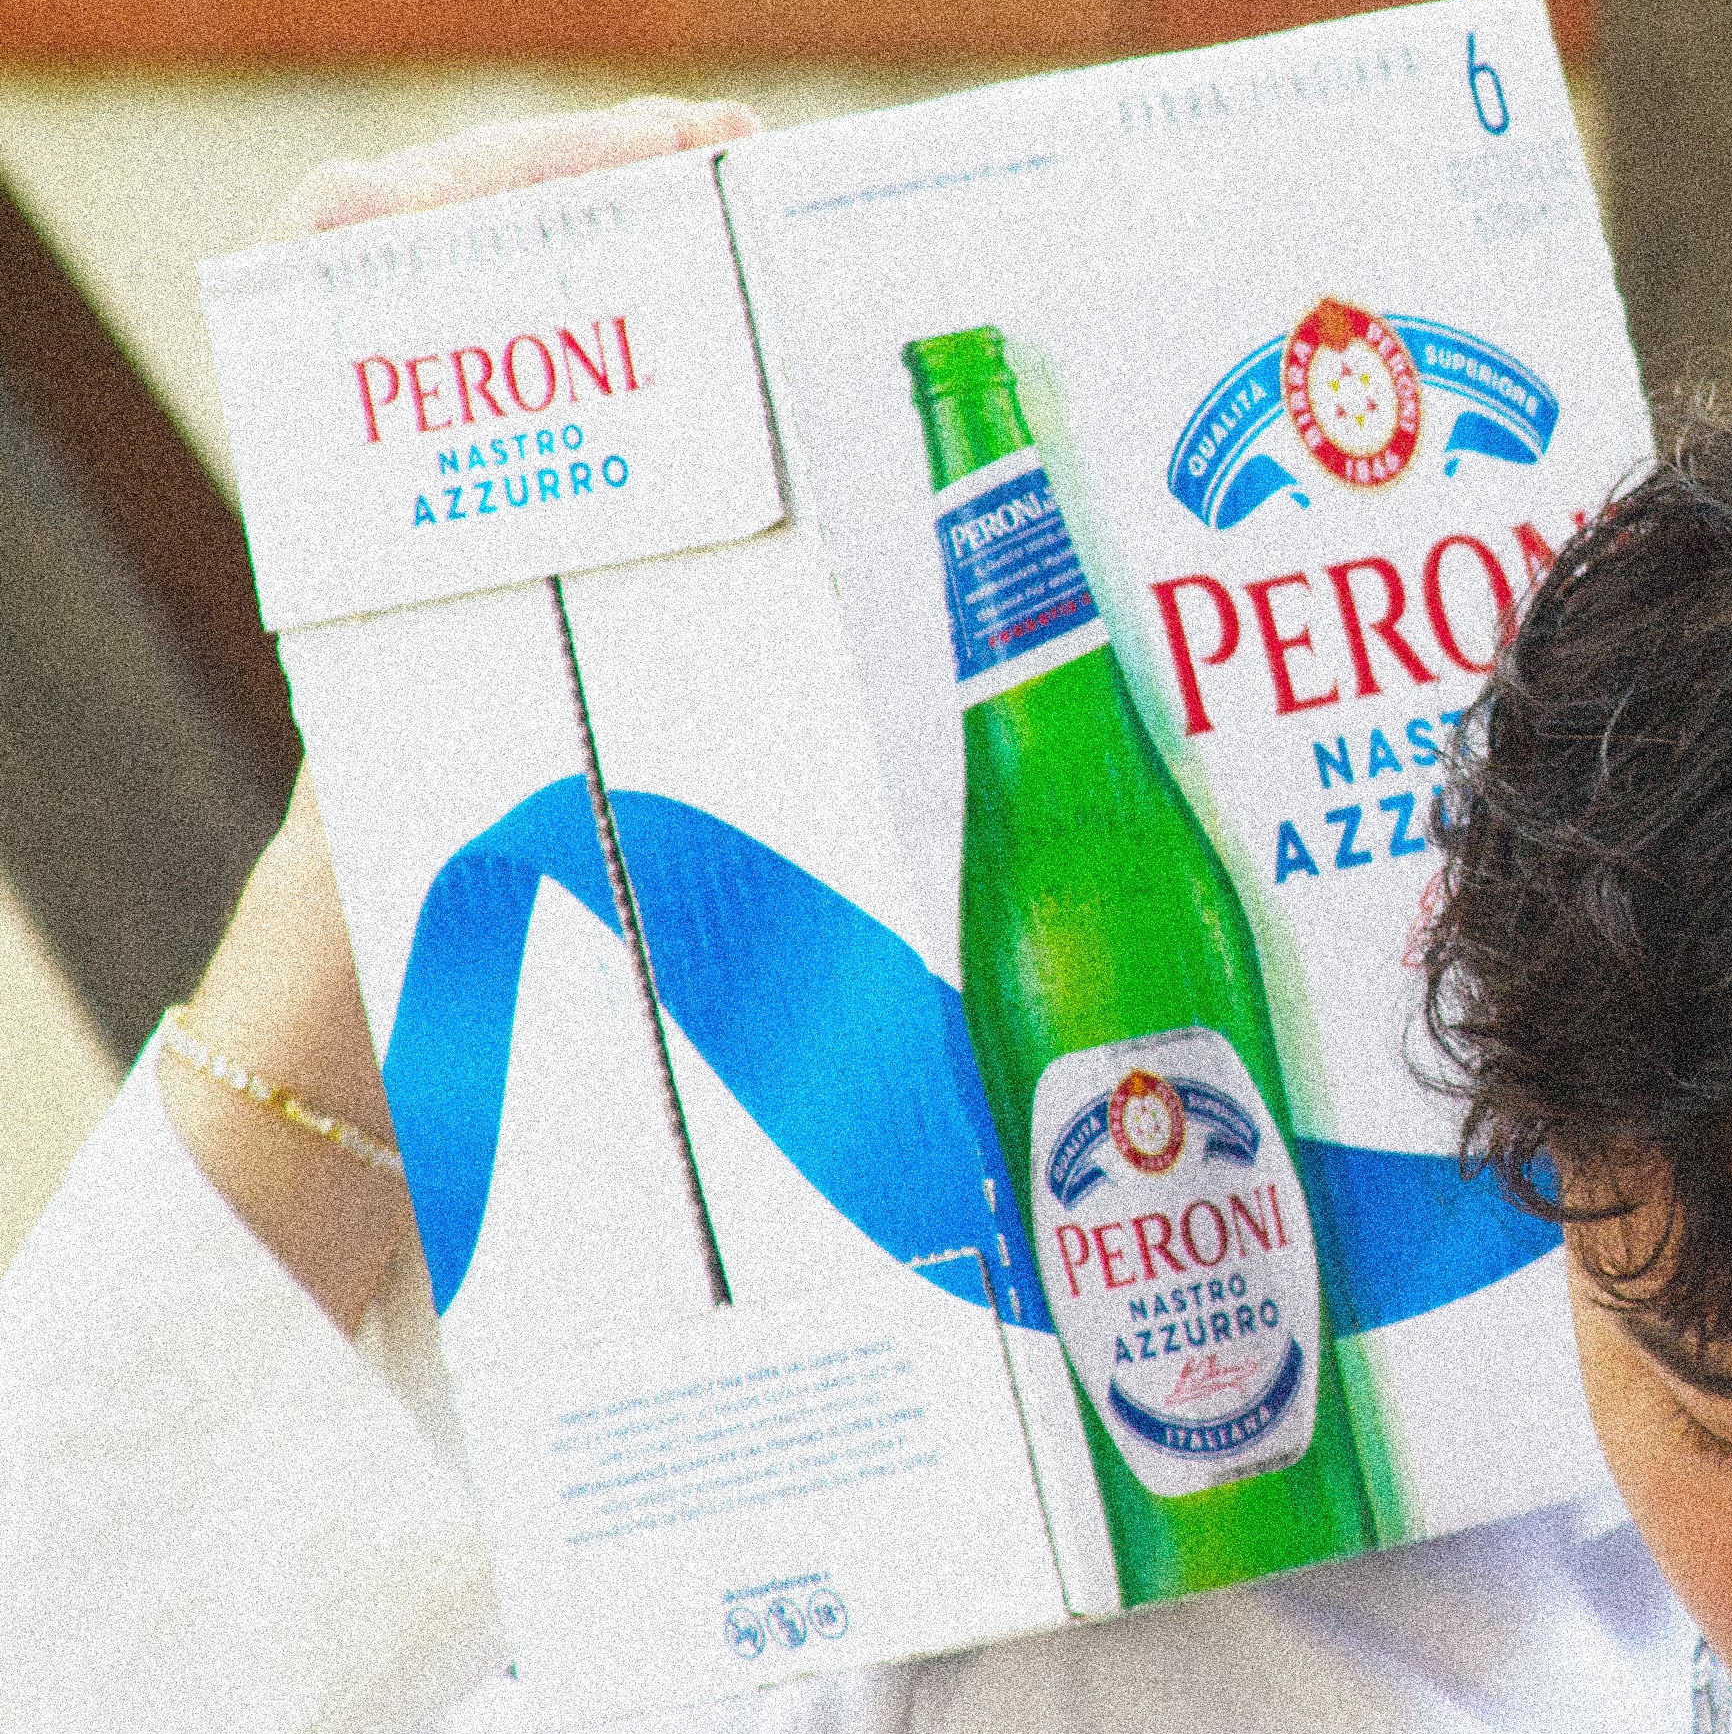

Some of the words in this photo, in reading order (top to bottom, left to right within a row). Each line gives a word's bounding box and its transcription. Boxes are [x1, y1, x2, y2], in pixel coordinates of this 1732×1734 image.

[1466, 32, 1513, 136] 6
[351, 316, 640, 444] PERONI
[1423, 342, 1540, 418] SUPERIORE
[437, 423, 584, 475] NASTRO
[411, 454, 631, 528] AZZURRO
[949, 492, 1044, 558] PERONI
[1150, 502, 1620, 737] PERO
[1053, 1183, 1292, 1298] PERONI
[1115, 1298, 1281, 1366] AZZURRO
[1129, 1272, 1247, 1324] NASTRO
[1164, 1403, 1273, 1450] ITALIANA
